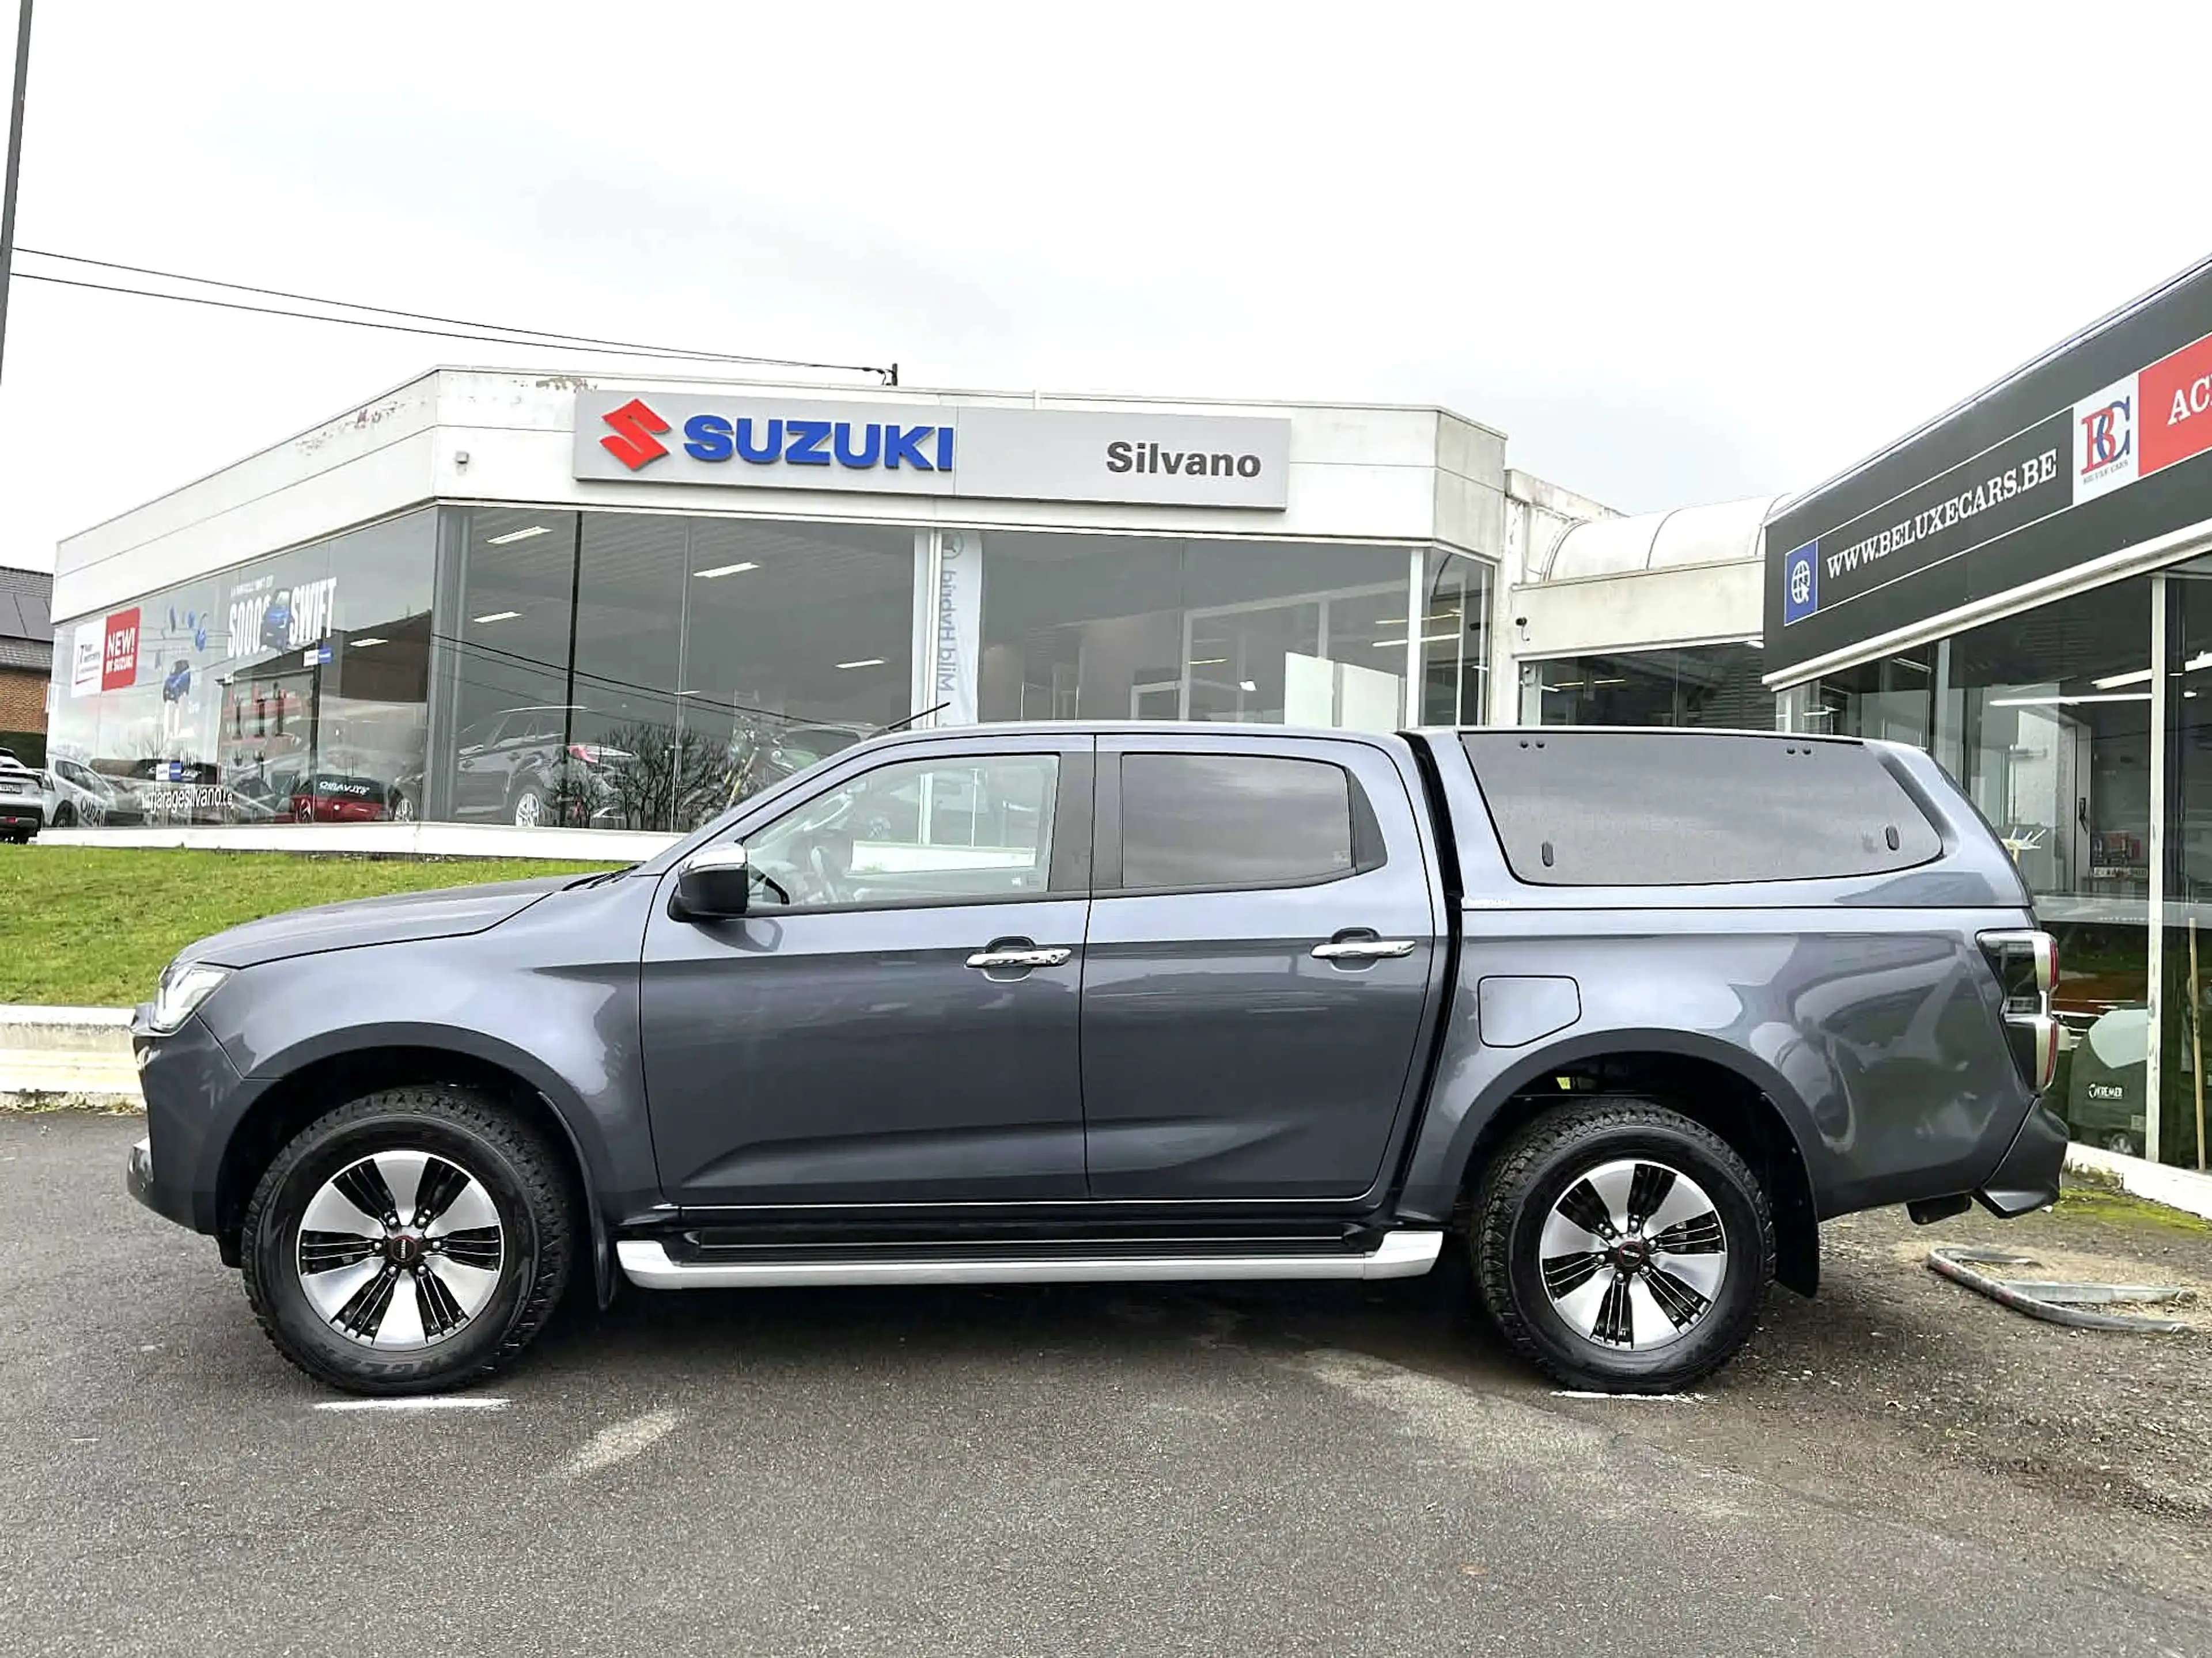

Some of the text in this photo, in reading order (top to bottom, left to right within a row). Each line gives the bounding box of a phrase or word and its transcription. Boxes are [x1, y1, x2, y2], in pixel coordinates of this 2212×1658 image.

[2167, 374, 2212, 426] AC
[683, 415, 954, 471] SUZUKI
[1107, 441, 1262, 477] Silvano
[1826, 448, 2058, 579] WWW.BELUXECARS.BE
[289, 576, 337, 646] SWIFT
[107, 627, 136, 659] NEW!
